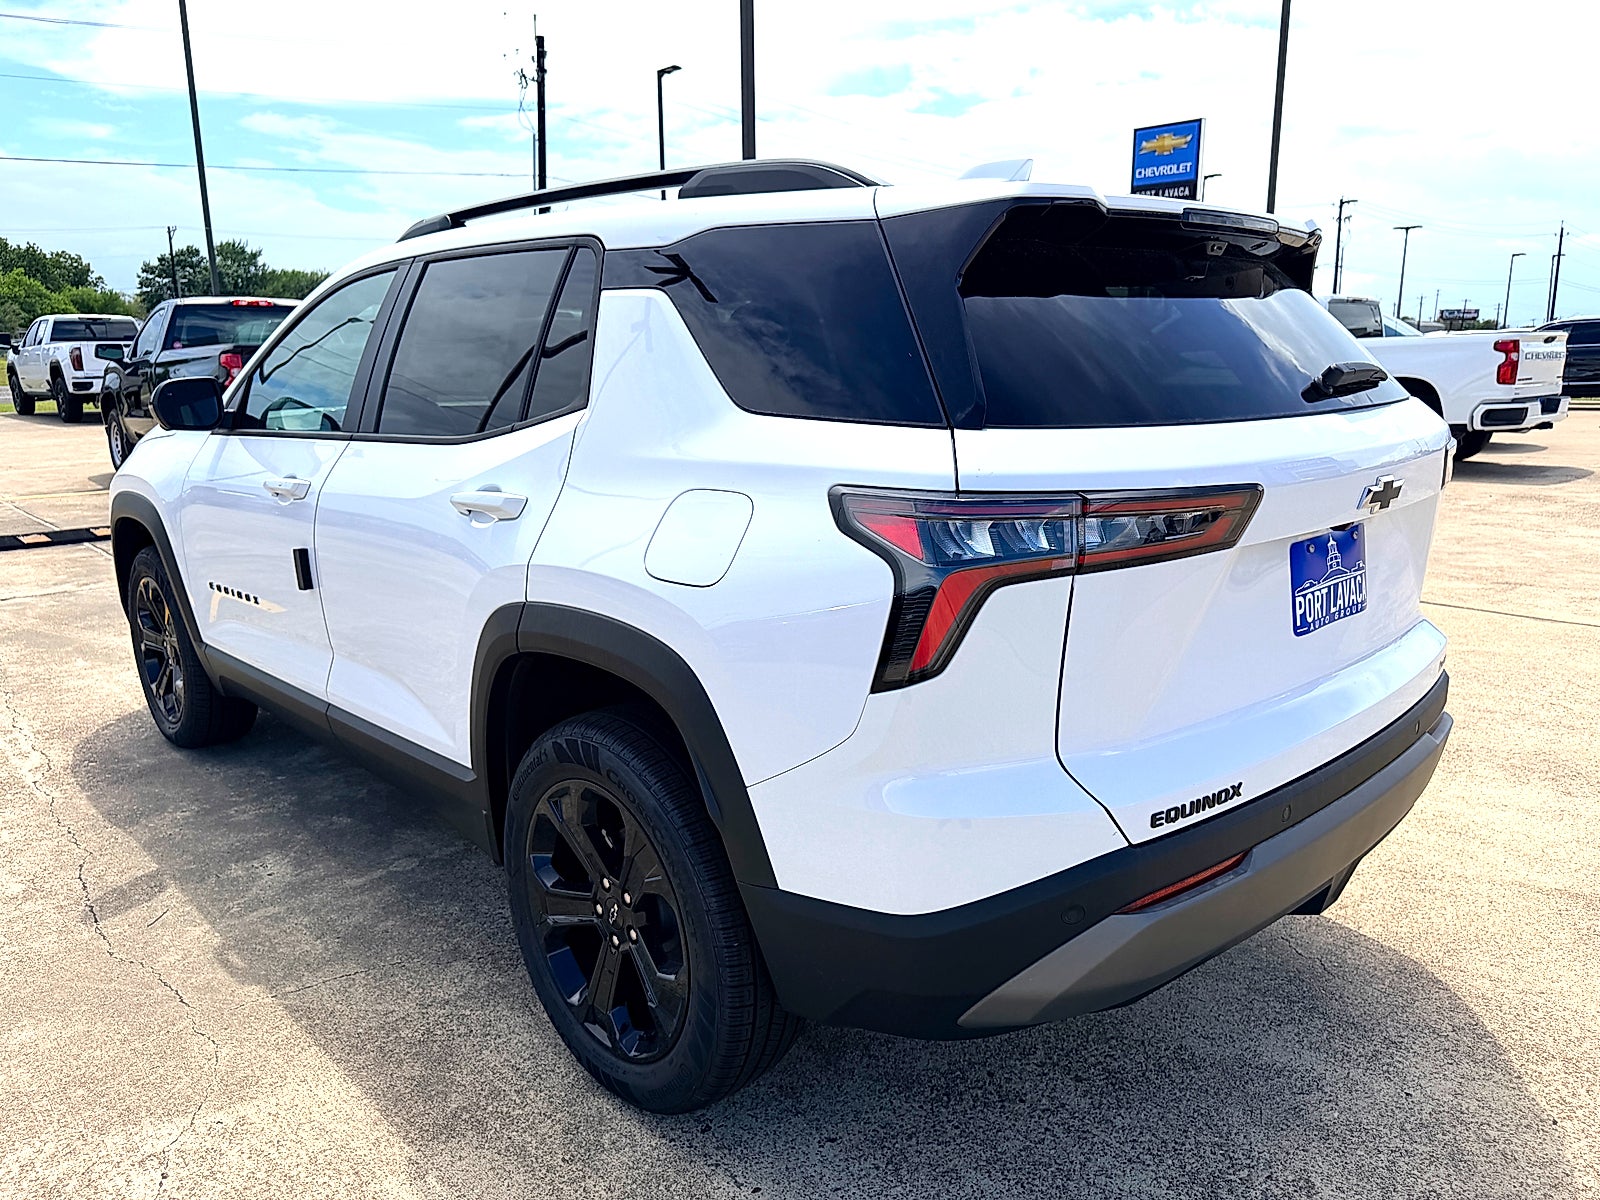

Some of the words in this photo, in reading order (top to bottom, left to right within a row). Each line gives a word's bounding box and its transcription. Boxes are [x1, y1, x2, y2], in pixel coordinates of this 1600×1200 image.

[1135, 162, 1192, 179] CHEVROLET
[1295, 587, 1328, 627] PORT
[1330, 573, 1367, 614] LAVACA
[1309, 615, 1330, 631] AUTO
[1334, 603, 1362, 620] GROUP
[1150, 782, 1243, 829] EQUINOX
